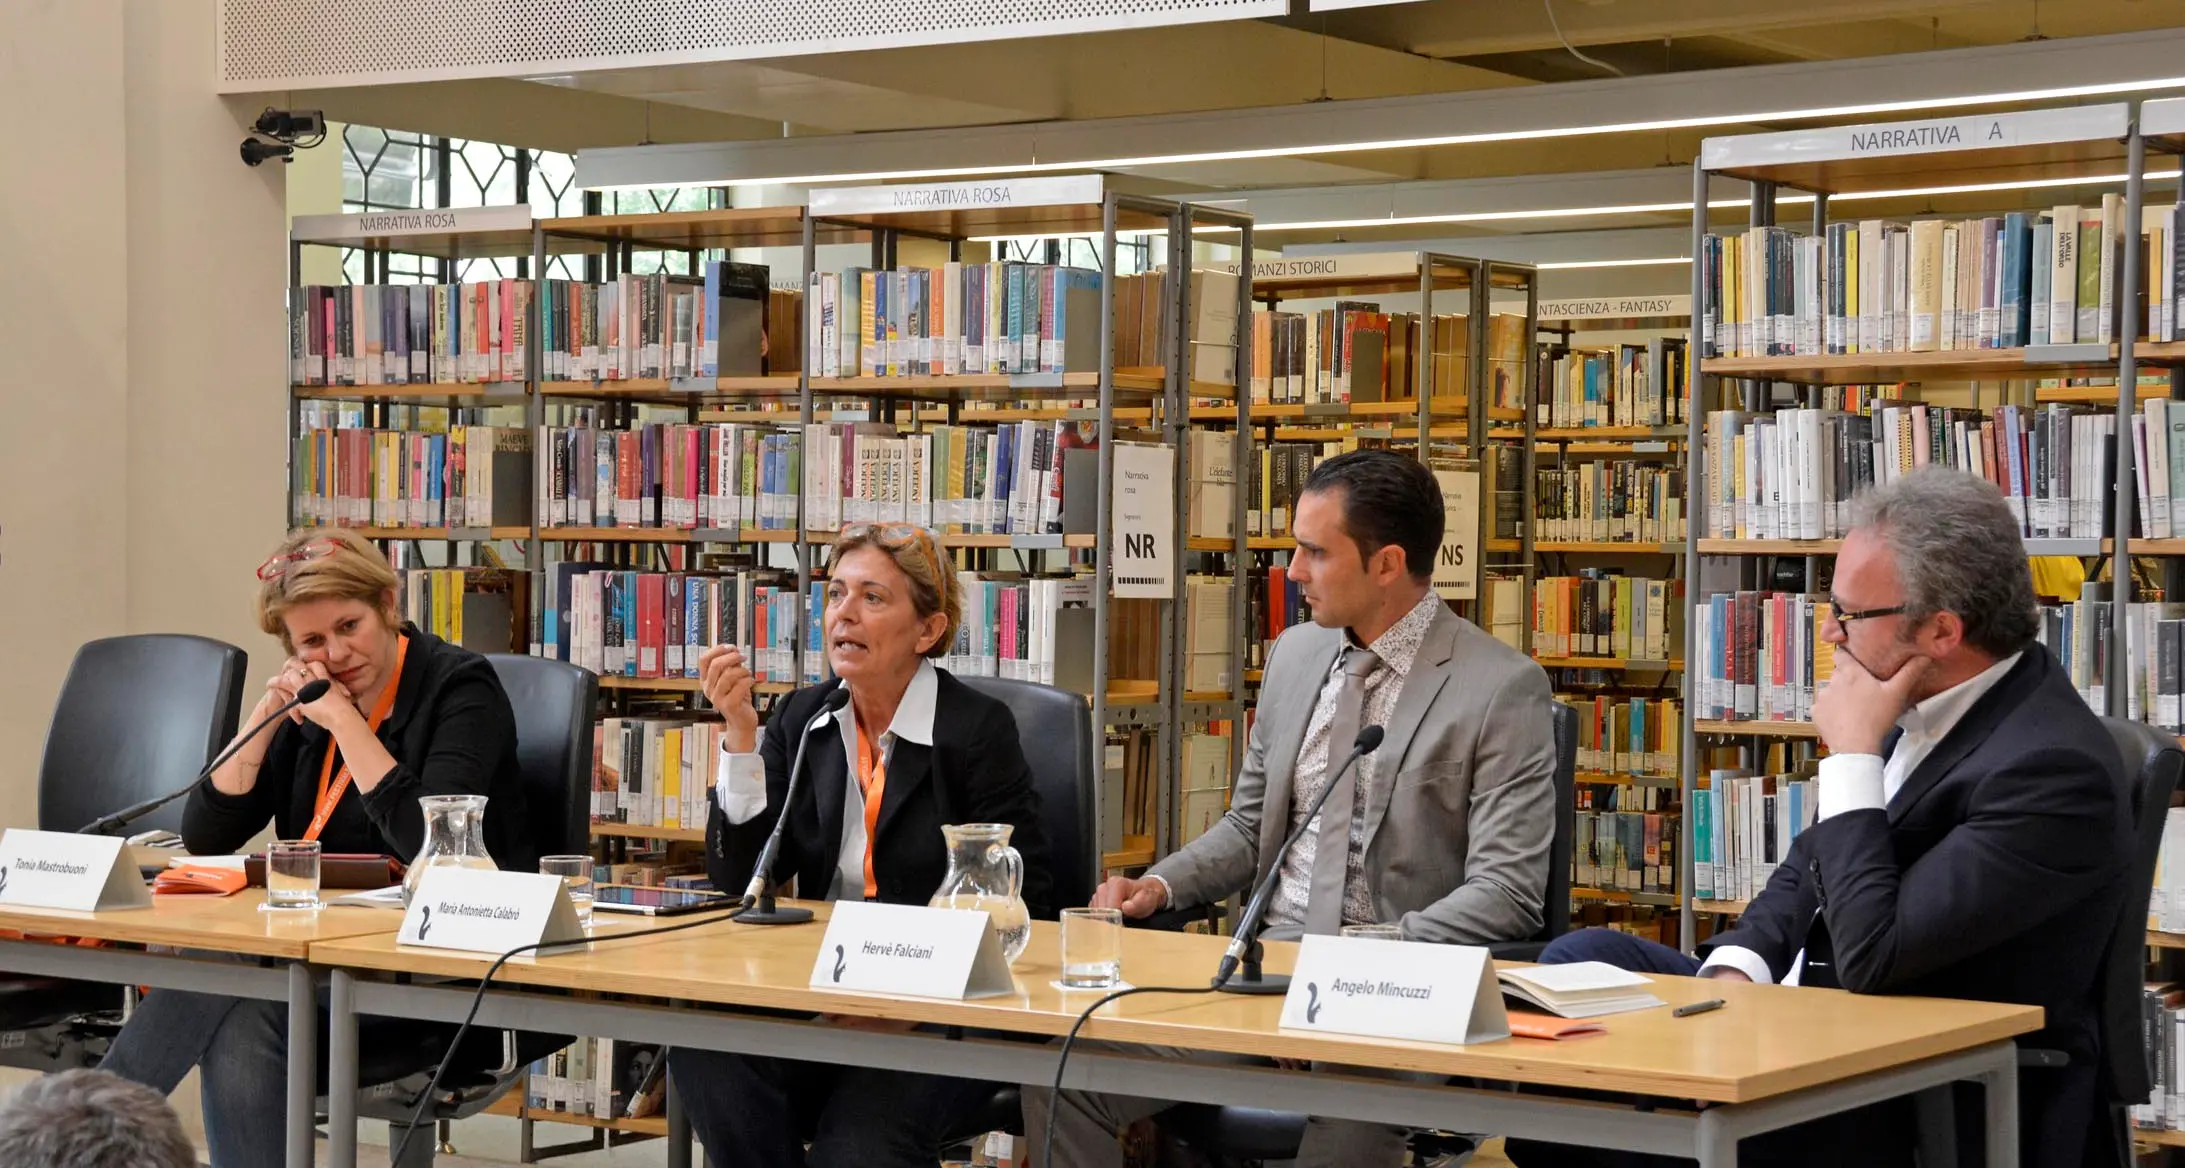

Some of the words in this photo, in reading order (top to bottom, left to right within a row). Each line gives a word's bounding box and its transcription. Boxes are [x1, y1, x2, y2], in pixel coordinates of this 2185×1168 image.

[1851, 125, 1961, 151] NARRATIVA
[1988, 121, 2003, 141] A
[893, 188, 969, 206] NARRATIVA
[973, 186, 1011, 204] ROSA
[359, 215, 422, 231] NARRATIVA
[425, 213, 456, 228] ROSA
[1289, 259, 1337, 275] STORICI
[1537, 302, 1610, 315] NTASCIENZA
[1620, 300, 1671, 313] FANTASY
[1125, 533, 1156, 559] NR
[1442, 545, 1464, 566] NS
[691, 602, 699, 631] DONNA
[15, 857, 36, 870] Tonia
[37, 860, 88, 875] Mastrobuoni
[438, 901, 458, 914] Maria
[458, 903, 493, 918] Antonietta
[893, 943, 934, 960] Falciani
[1331, 977, 1375, 997] Angelo
[1376, 981, 1433, 1001] Mincuzzi
